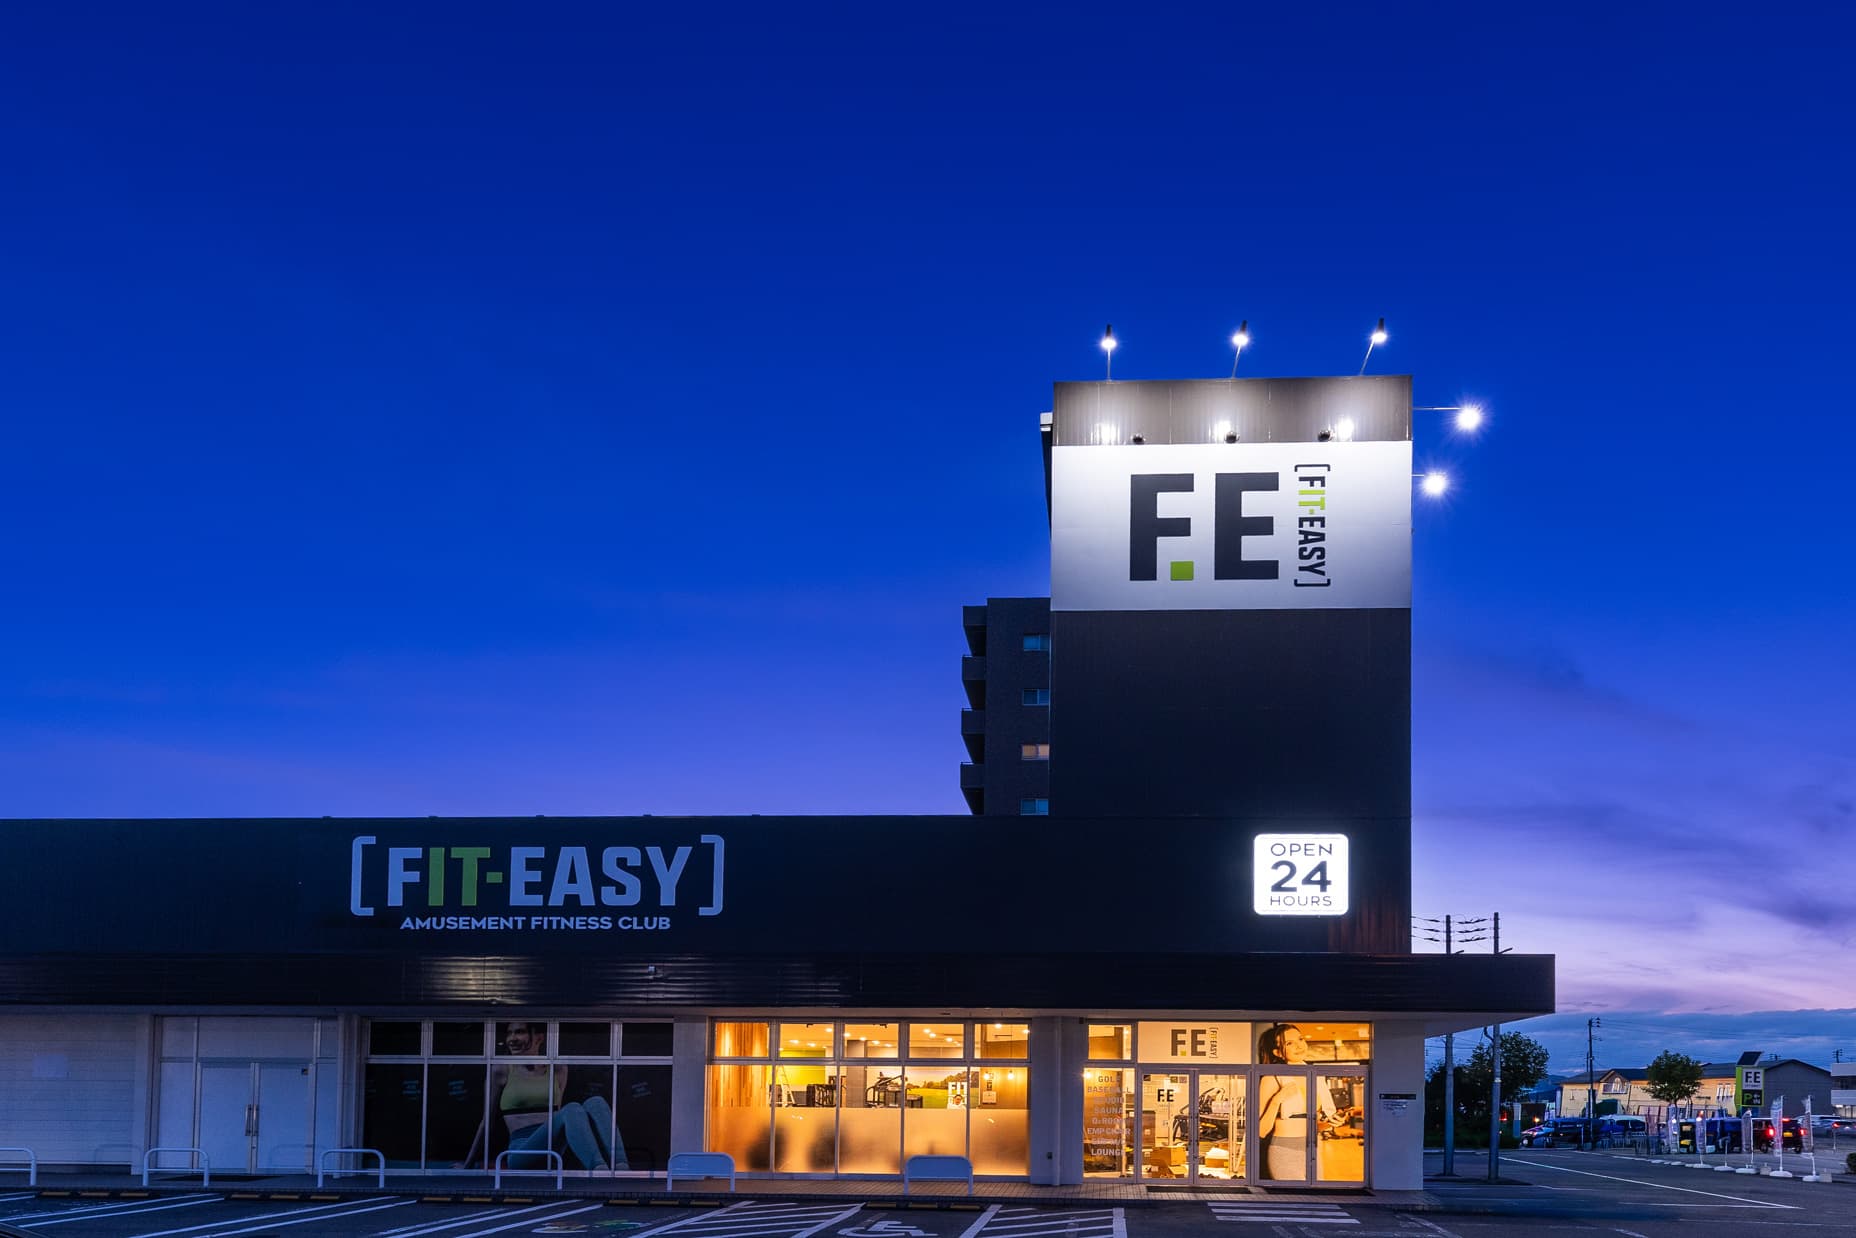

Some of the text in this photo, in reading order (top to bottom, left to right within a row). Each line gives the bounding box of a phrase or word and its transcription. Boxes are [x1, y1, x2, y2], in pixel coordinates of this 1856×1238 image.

[1270, 843, 1332, 856] OPEN
[1270, 860, 1332, 893] 24
[1269, 895, 1332, 906] HOURS
[400, 916, 671, 930] AMUSEMENT FITNESS CLUB
